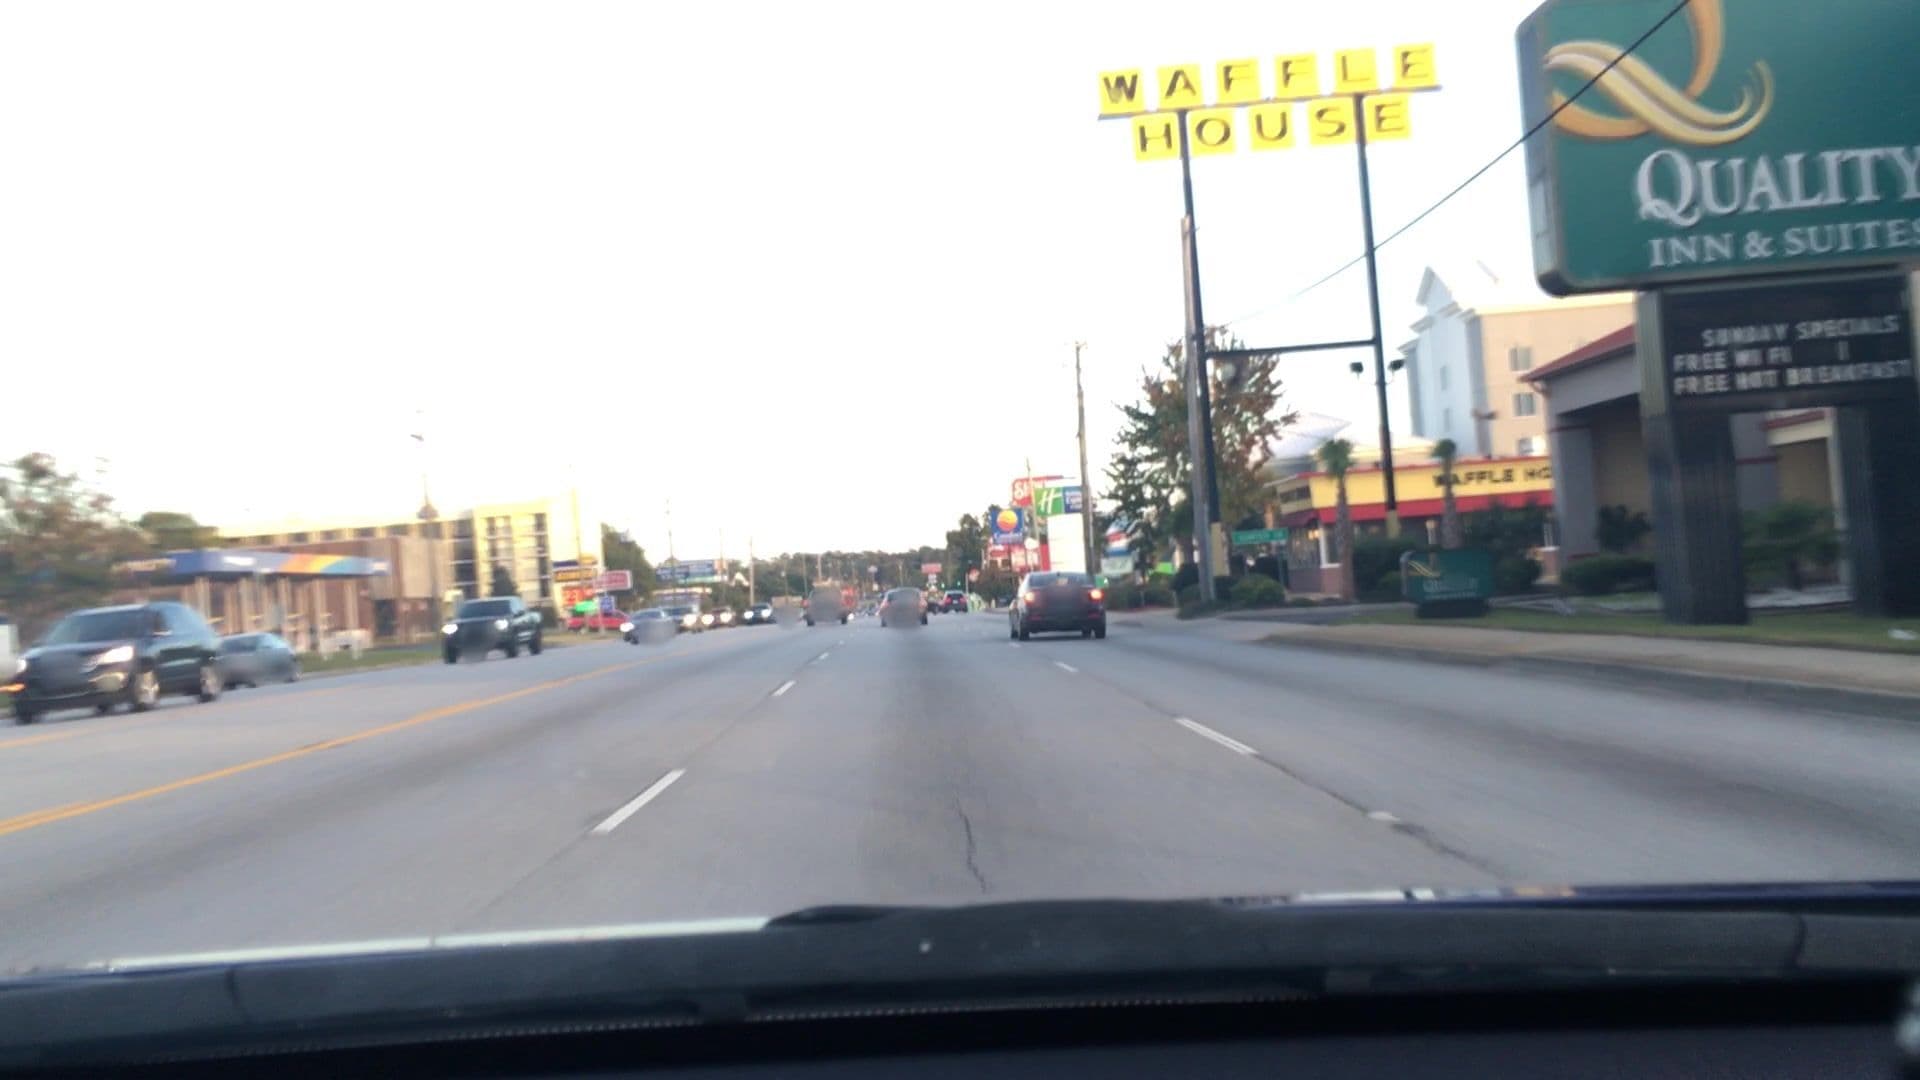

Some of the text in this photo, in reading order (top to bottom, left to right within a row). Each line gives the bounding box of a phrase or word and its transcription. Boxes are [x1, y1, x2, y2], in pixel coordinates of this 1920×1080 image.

[1103, 47, 1432, 104] WAFFLE
[1138, 102, 1406, 153] HOUSE
[1636, 145, 1920, 227] QUALITY
[1648, 232, 1735, 267] INN
[1744, 230, 1775, 260] &
[1795, 314, 1899, 340] SPECIALS
[1672, 351, 1728, 373] FREE
[1673, 373, 1730, 396] FREE
